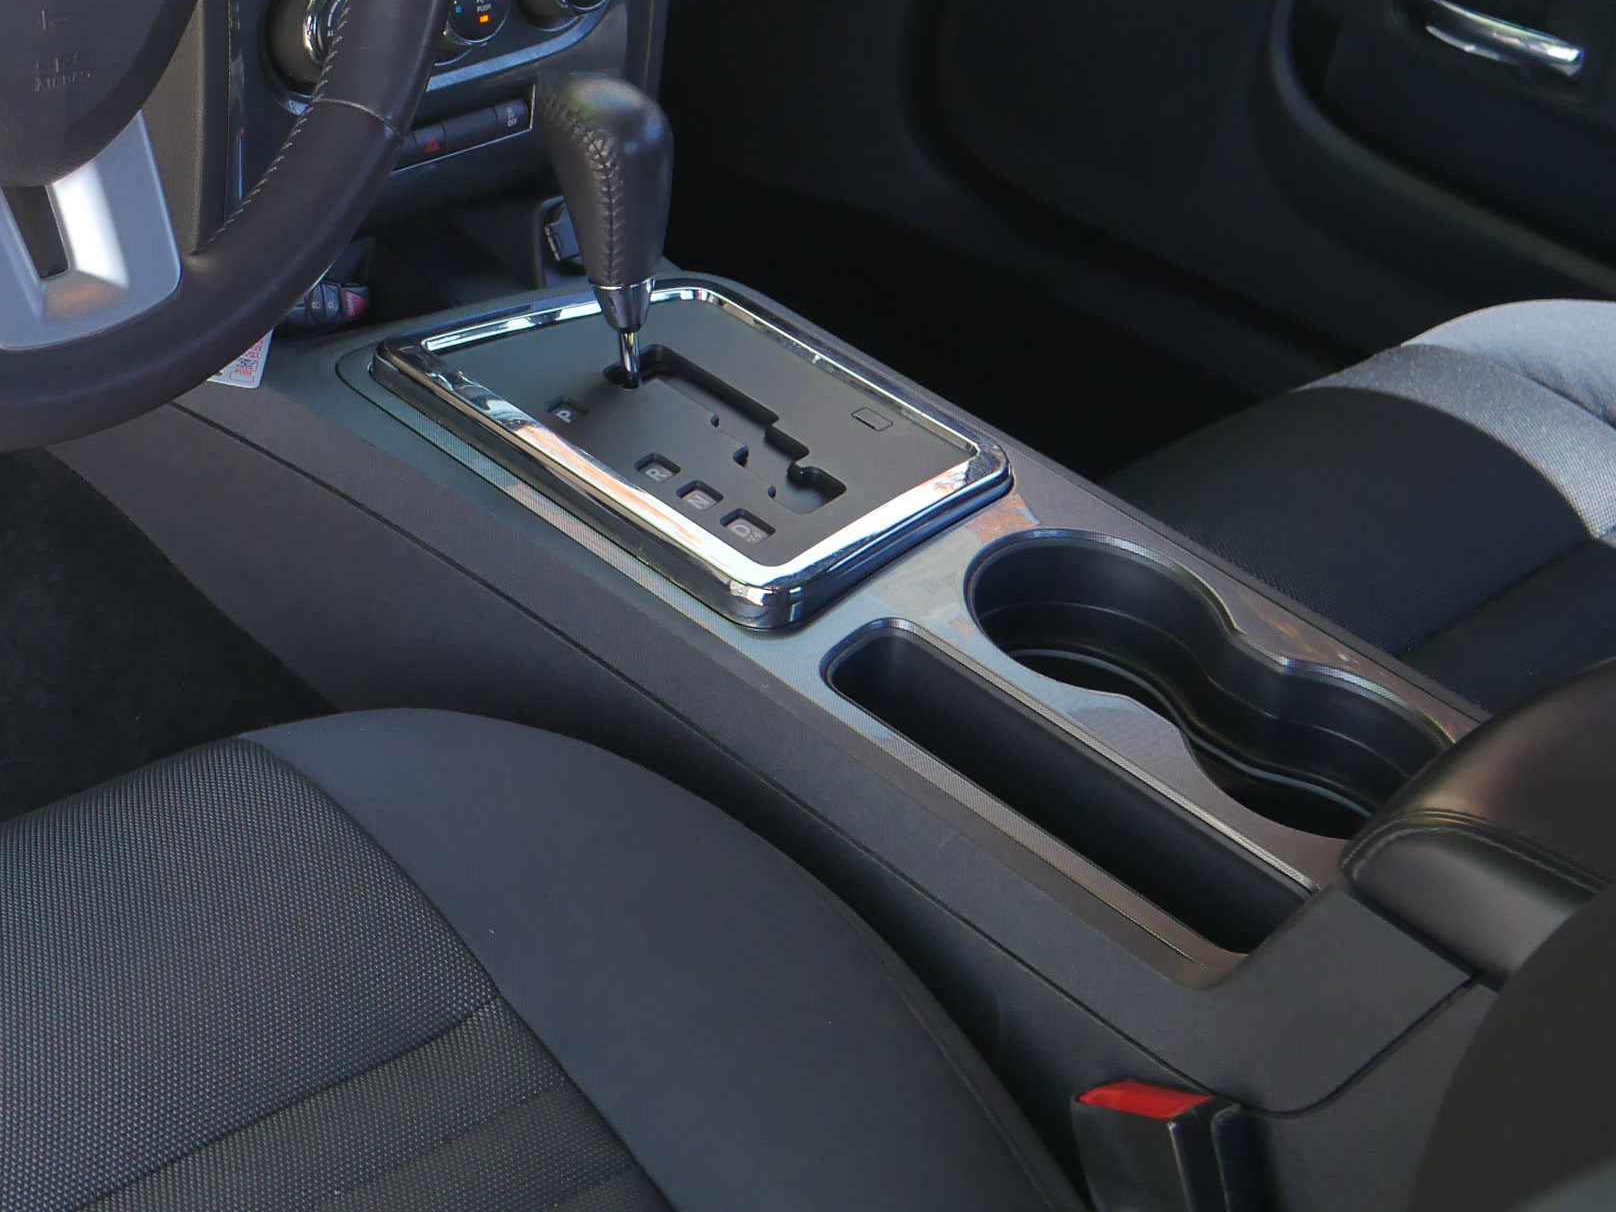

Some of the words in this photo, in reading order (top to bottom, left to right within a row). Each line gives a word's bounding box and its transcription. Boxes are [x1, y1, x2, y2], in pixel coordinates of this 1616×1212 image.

[555, 409, 572, 424] P
[644, 468, 668, 483] R
[686, 494, 712, 511] N
[729, 523, 751, 539] D
